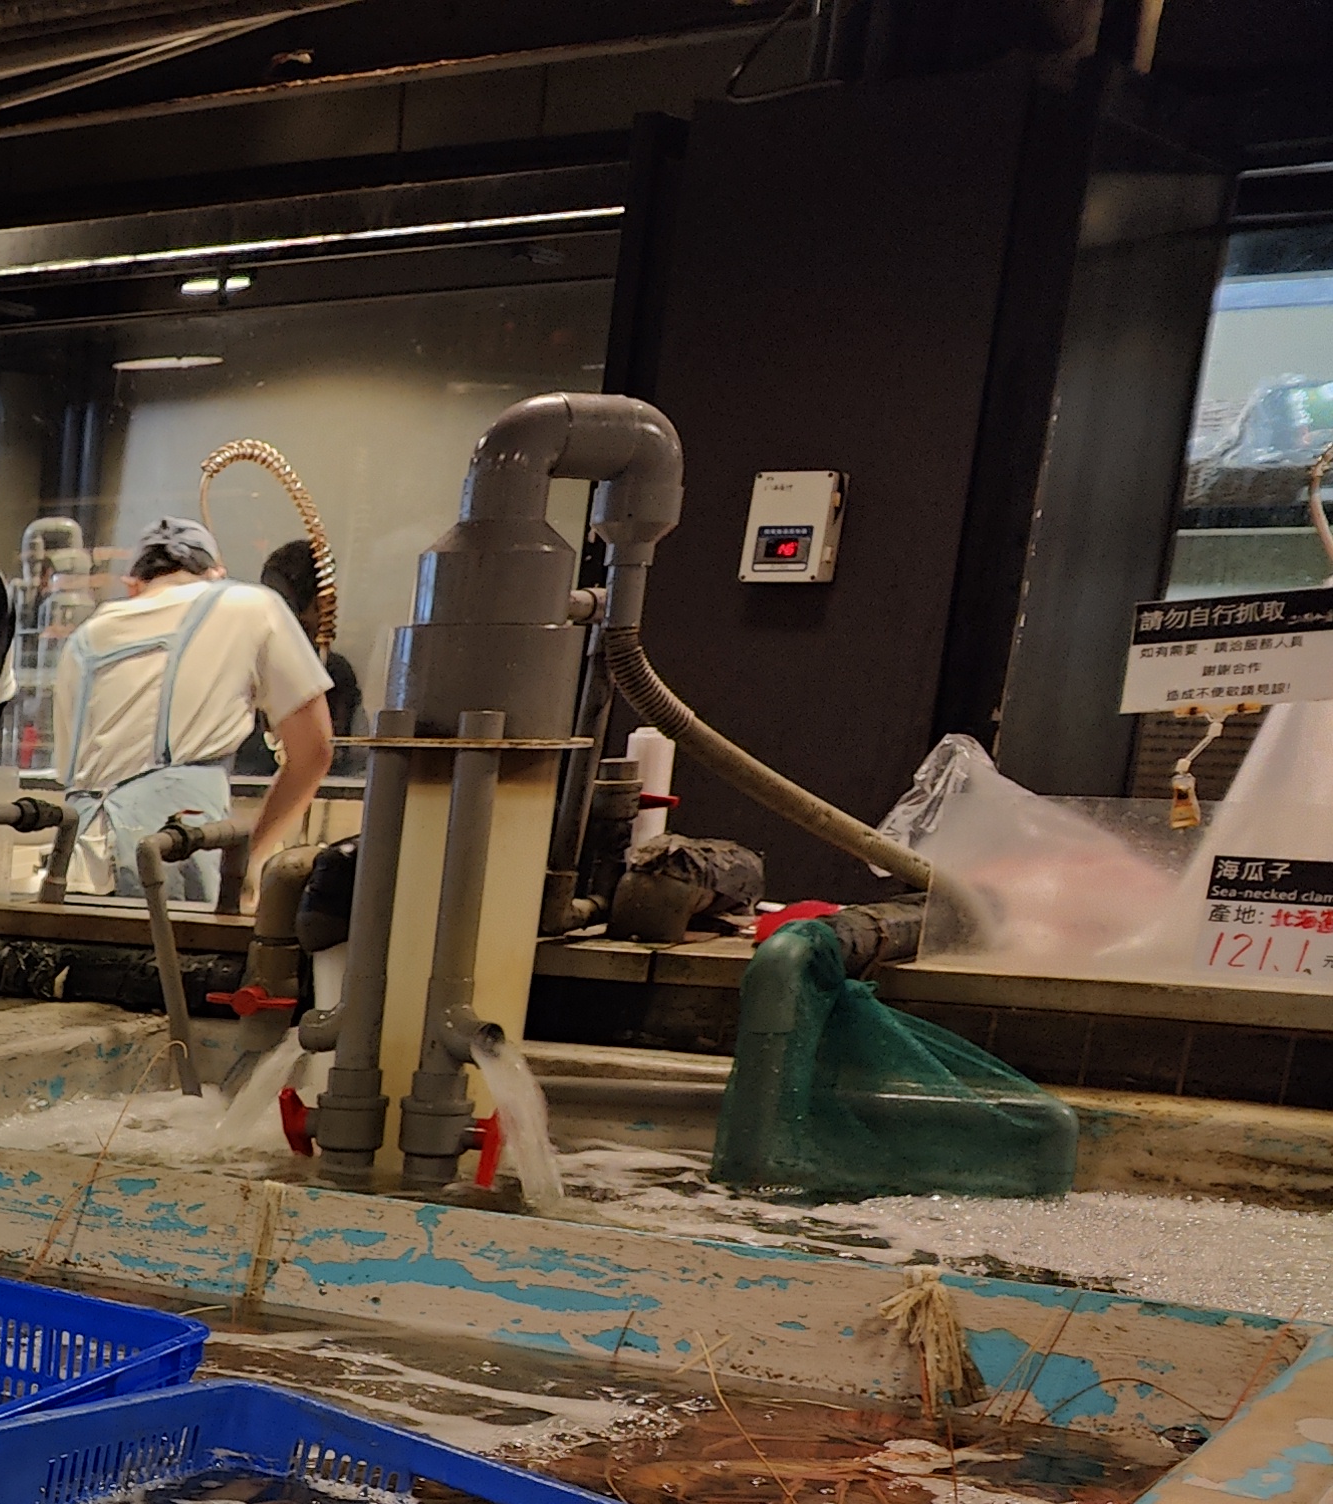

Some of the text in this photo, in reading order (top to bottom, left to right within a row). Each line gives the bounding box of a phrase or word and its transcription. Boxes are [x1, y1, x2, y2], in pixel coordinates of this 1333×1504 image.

[1139, 601, 1286, 631] 請勿自行抓取
[1202, 662, 1262, 677] 謝謝合作
[1215, 859, 1291, 881] 海瓜子
[1211, 885, 1298, 901] Sea-necked
